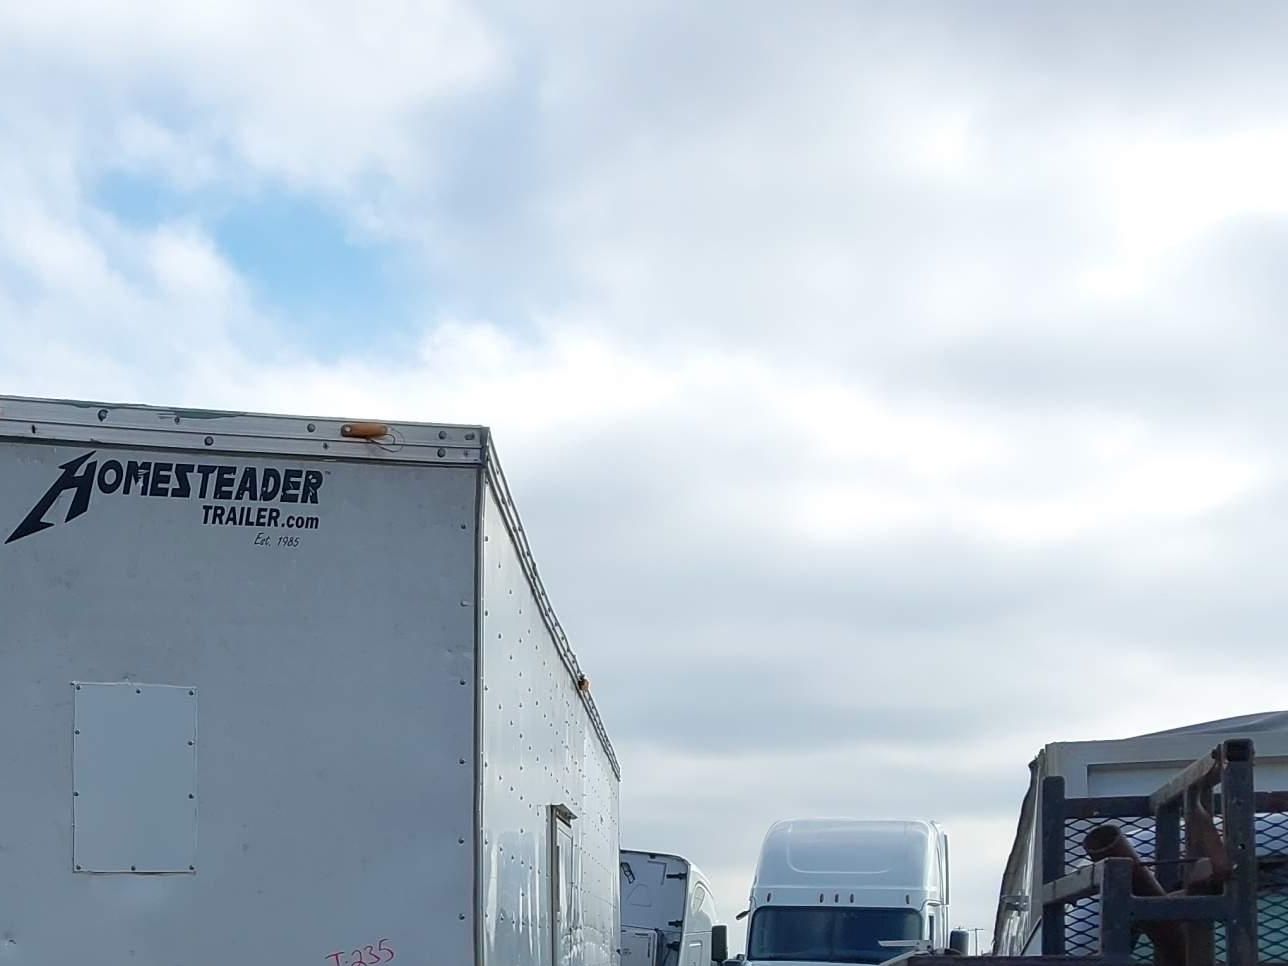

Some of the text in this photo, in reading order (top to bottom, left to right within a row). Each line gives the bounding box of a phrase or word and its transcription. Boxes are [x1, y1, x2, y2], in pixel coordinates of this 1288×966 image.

[4, 450, 325, 545] HOMESTEADER
[202, 504, 320, 530] TRAILER.com
[253, 532, 300, 548] Est. 1985
